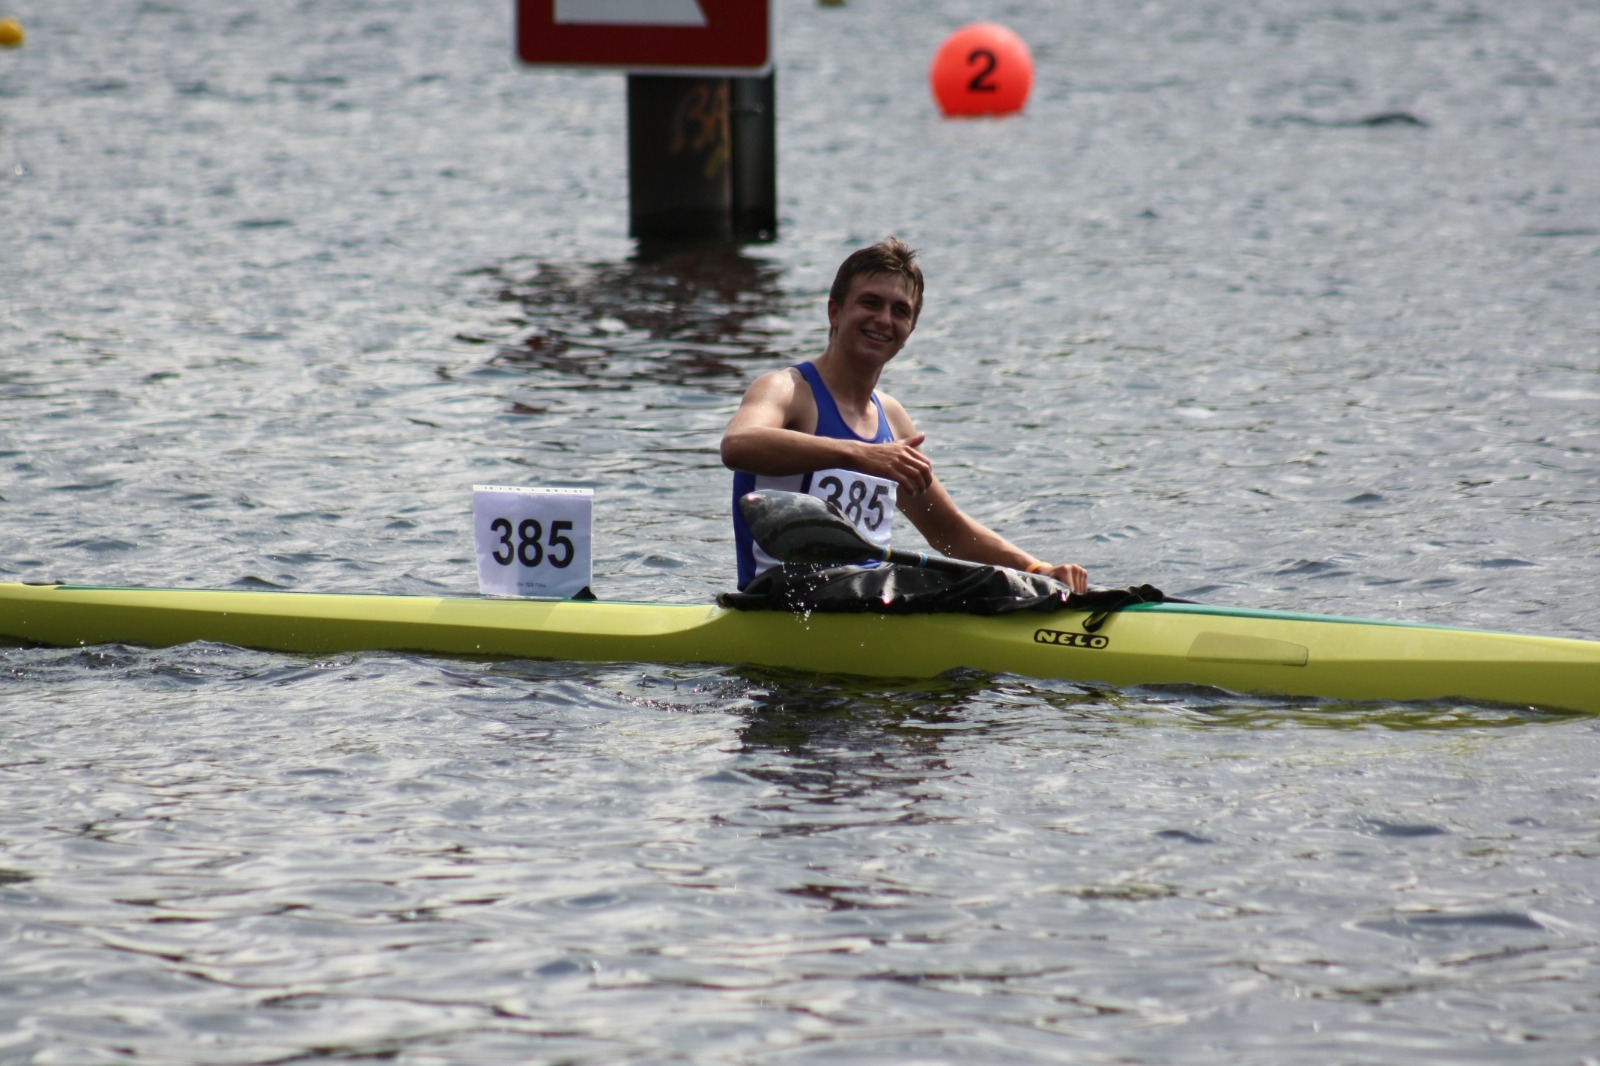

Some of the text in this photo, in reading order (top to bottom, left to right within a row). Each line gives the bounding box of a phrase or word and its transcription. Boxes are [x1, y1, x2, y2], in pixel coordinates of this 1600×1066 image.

[967, 47, 998, 93] 2
[818, 475, 889, 532] 385
[490, 517, 575, 569] 385
[1036, 630, 1107, 648] NELO
